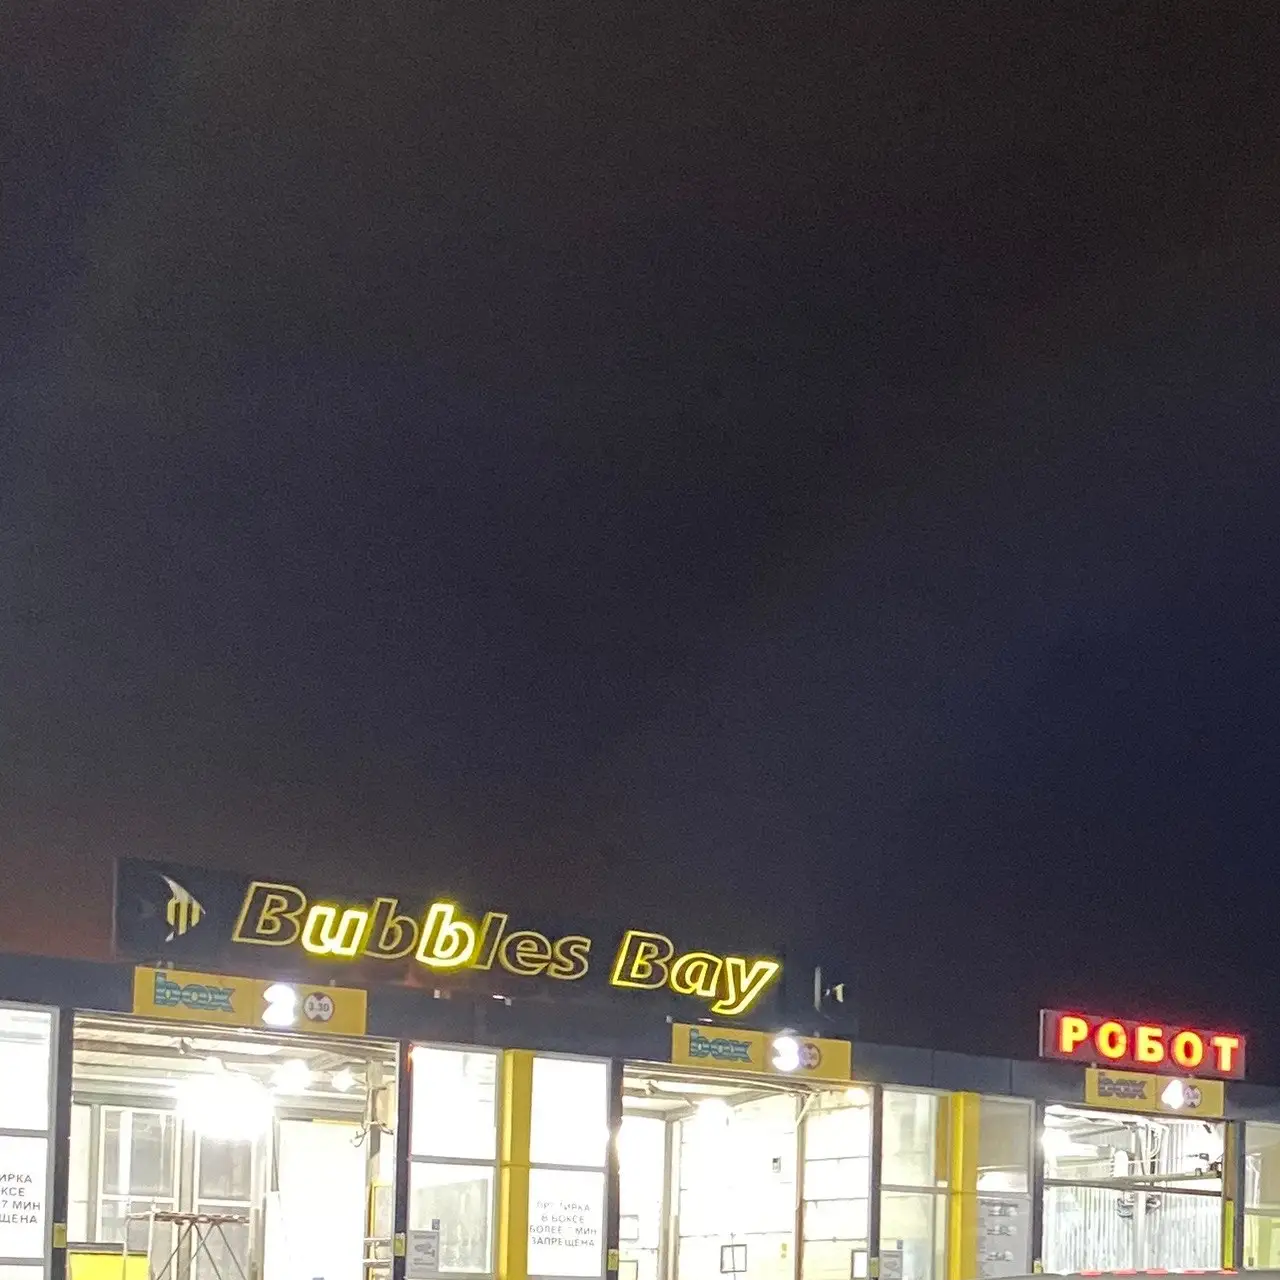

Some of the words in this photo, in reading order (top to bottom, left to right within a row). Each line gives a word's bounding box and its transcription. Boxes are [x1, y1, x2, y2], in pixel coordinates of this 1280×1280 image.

[231, 880, 592, 980] Bubbles
[611, 929, 781, 1015] Bay
[154, 971, 236, 1013] box
[261, 984, 297, 1027] 2
[688, 1027, 754, 1064] box
[771, 1035, 800, 1072] 3
[1060, 1014, 1240, 1073] РОБОТ
[12, 1200, 41, 1211] МИН
